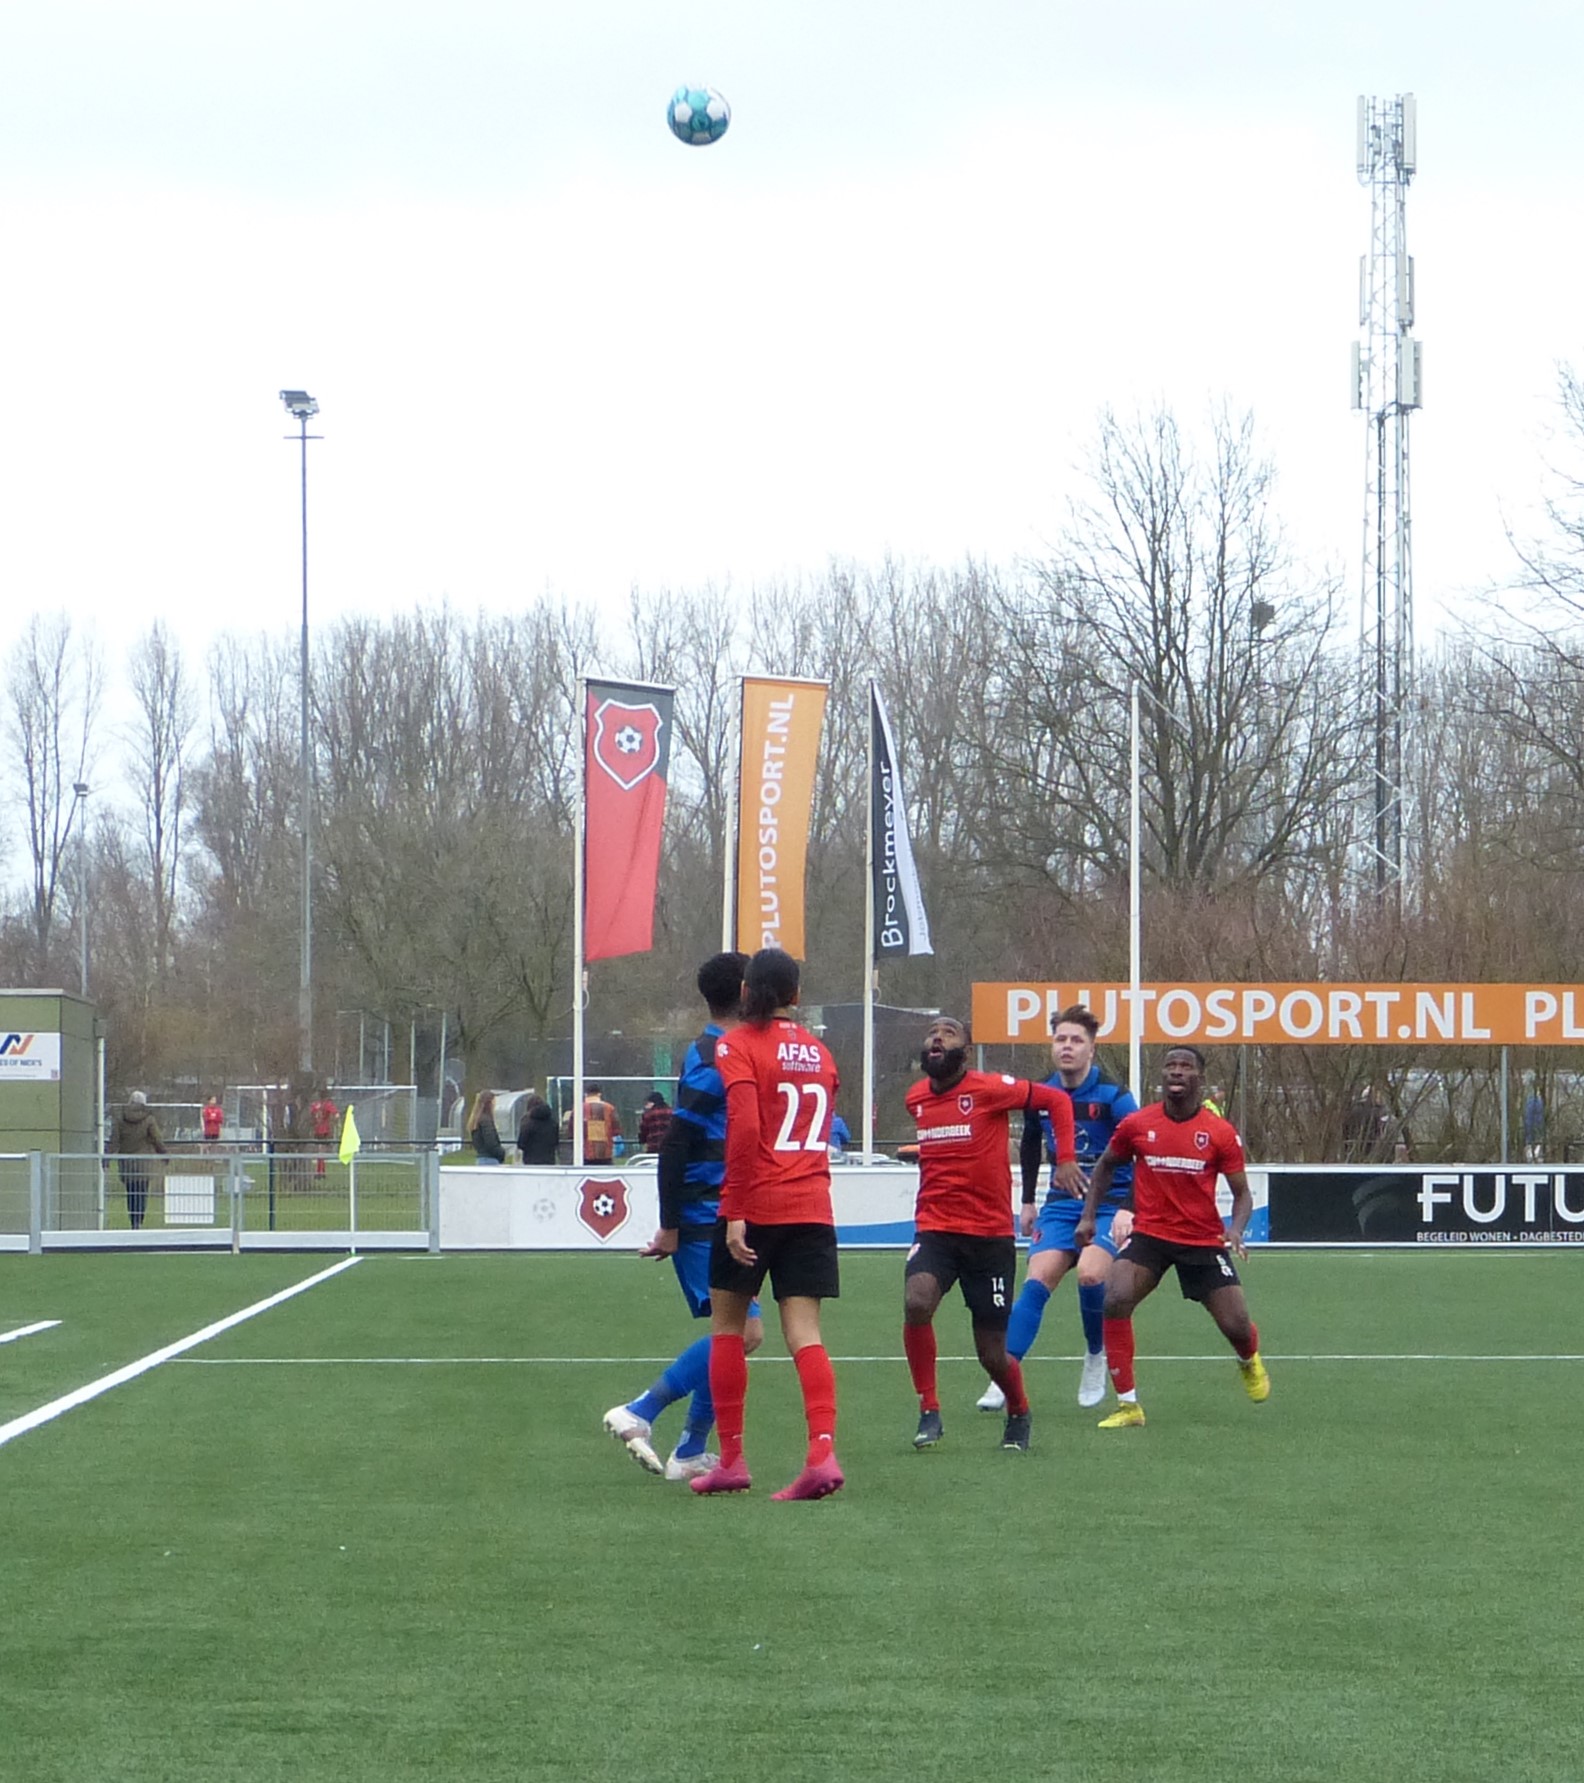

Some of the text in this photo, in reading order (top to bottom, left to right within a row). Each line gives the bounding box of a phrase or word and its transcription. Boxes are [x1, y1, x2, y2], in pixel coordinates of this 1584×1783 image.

[759, 693, 794, 951] PLUTOSPORT.NL
[776, 1042, 821, 1063] AFAS
[774, 1082, 828, 1151] 22
[1417, 1231, 1468, 1243] BEGELEID
[1470, 1231, 1511, 1243] WONEN
[992, 1277, 1005, 1292] 14
